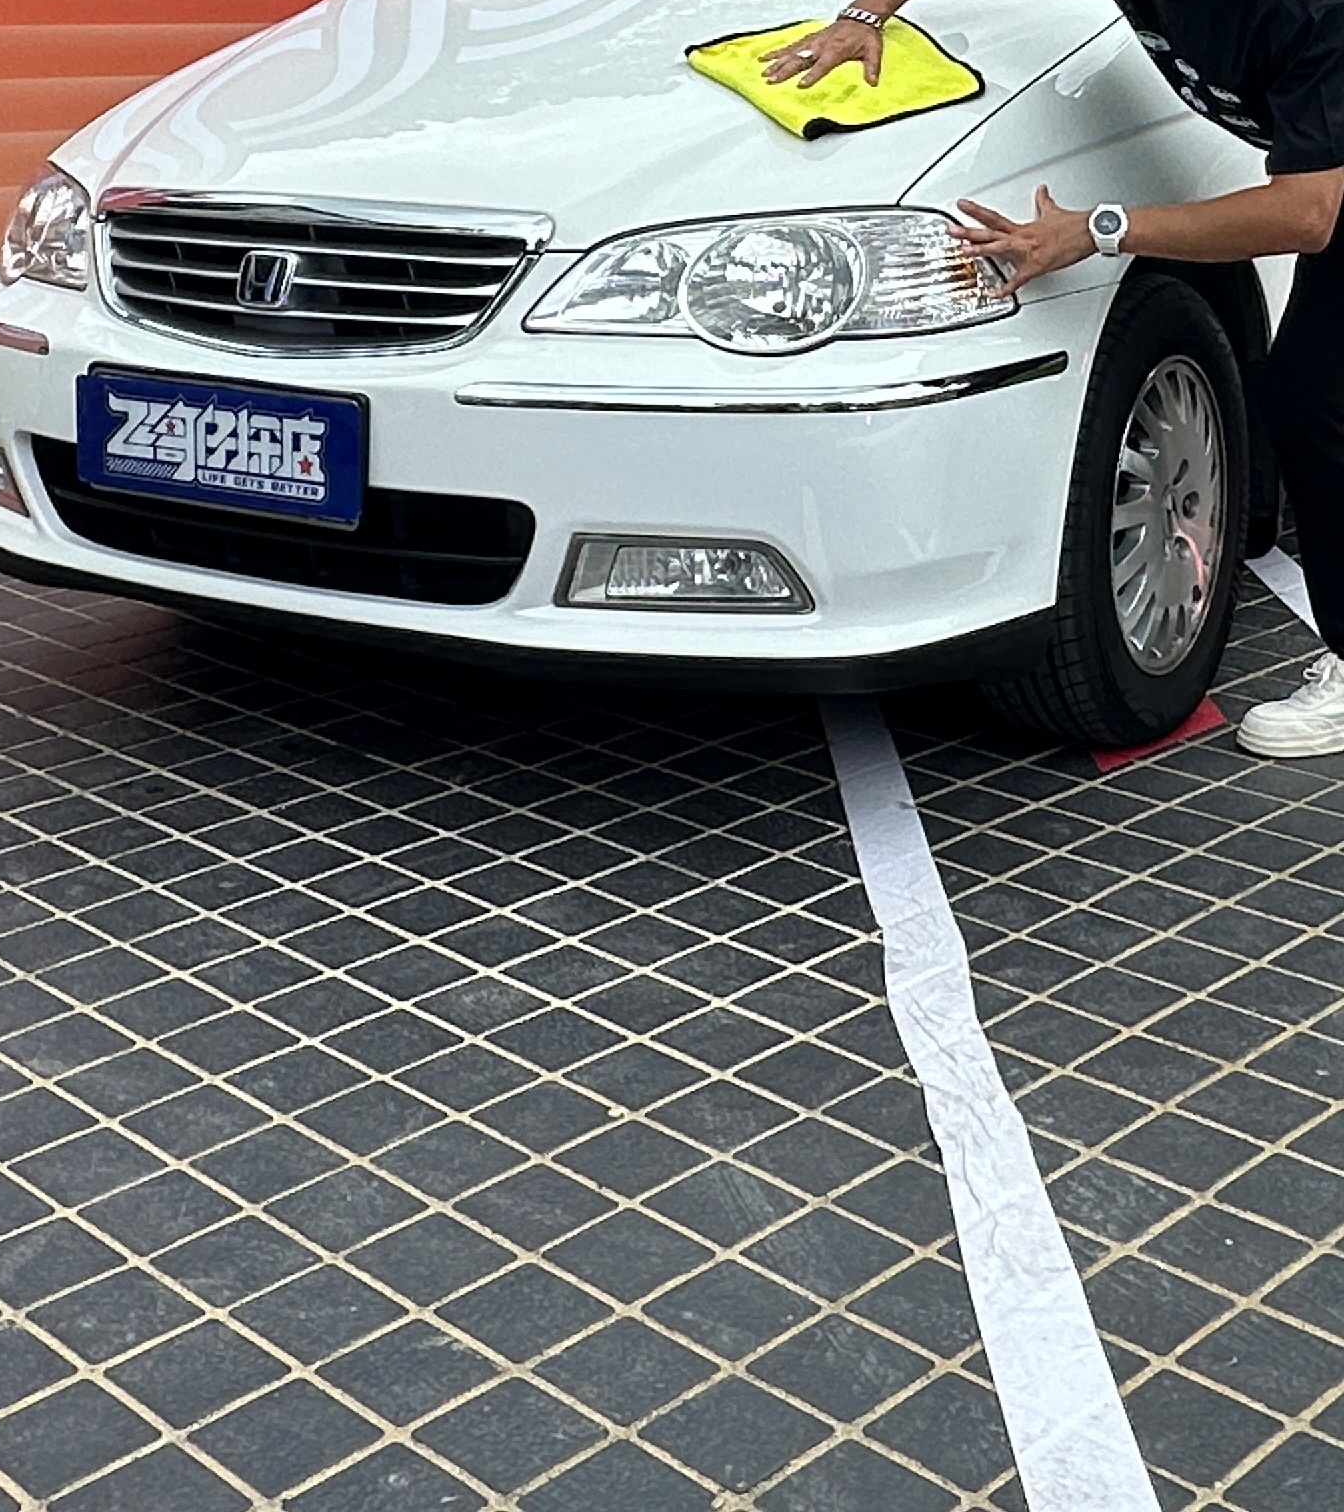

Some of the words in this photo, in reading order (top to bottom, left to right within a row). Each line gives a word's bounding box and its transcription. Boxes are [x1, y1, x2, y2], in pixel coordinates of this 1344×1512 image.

[202, 470, 226, 484] LIFE
[233, 475, 264, 490] GETS
[270, 481, 320, 497] BETTER
